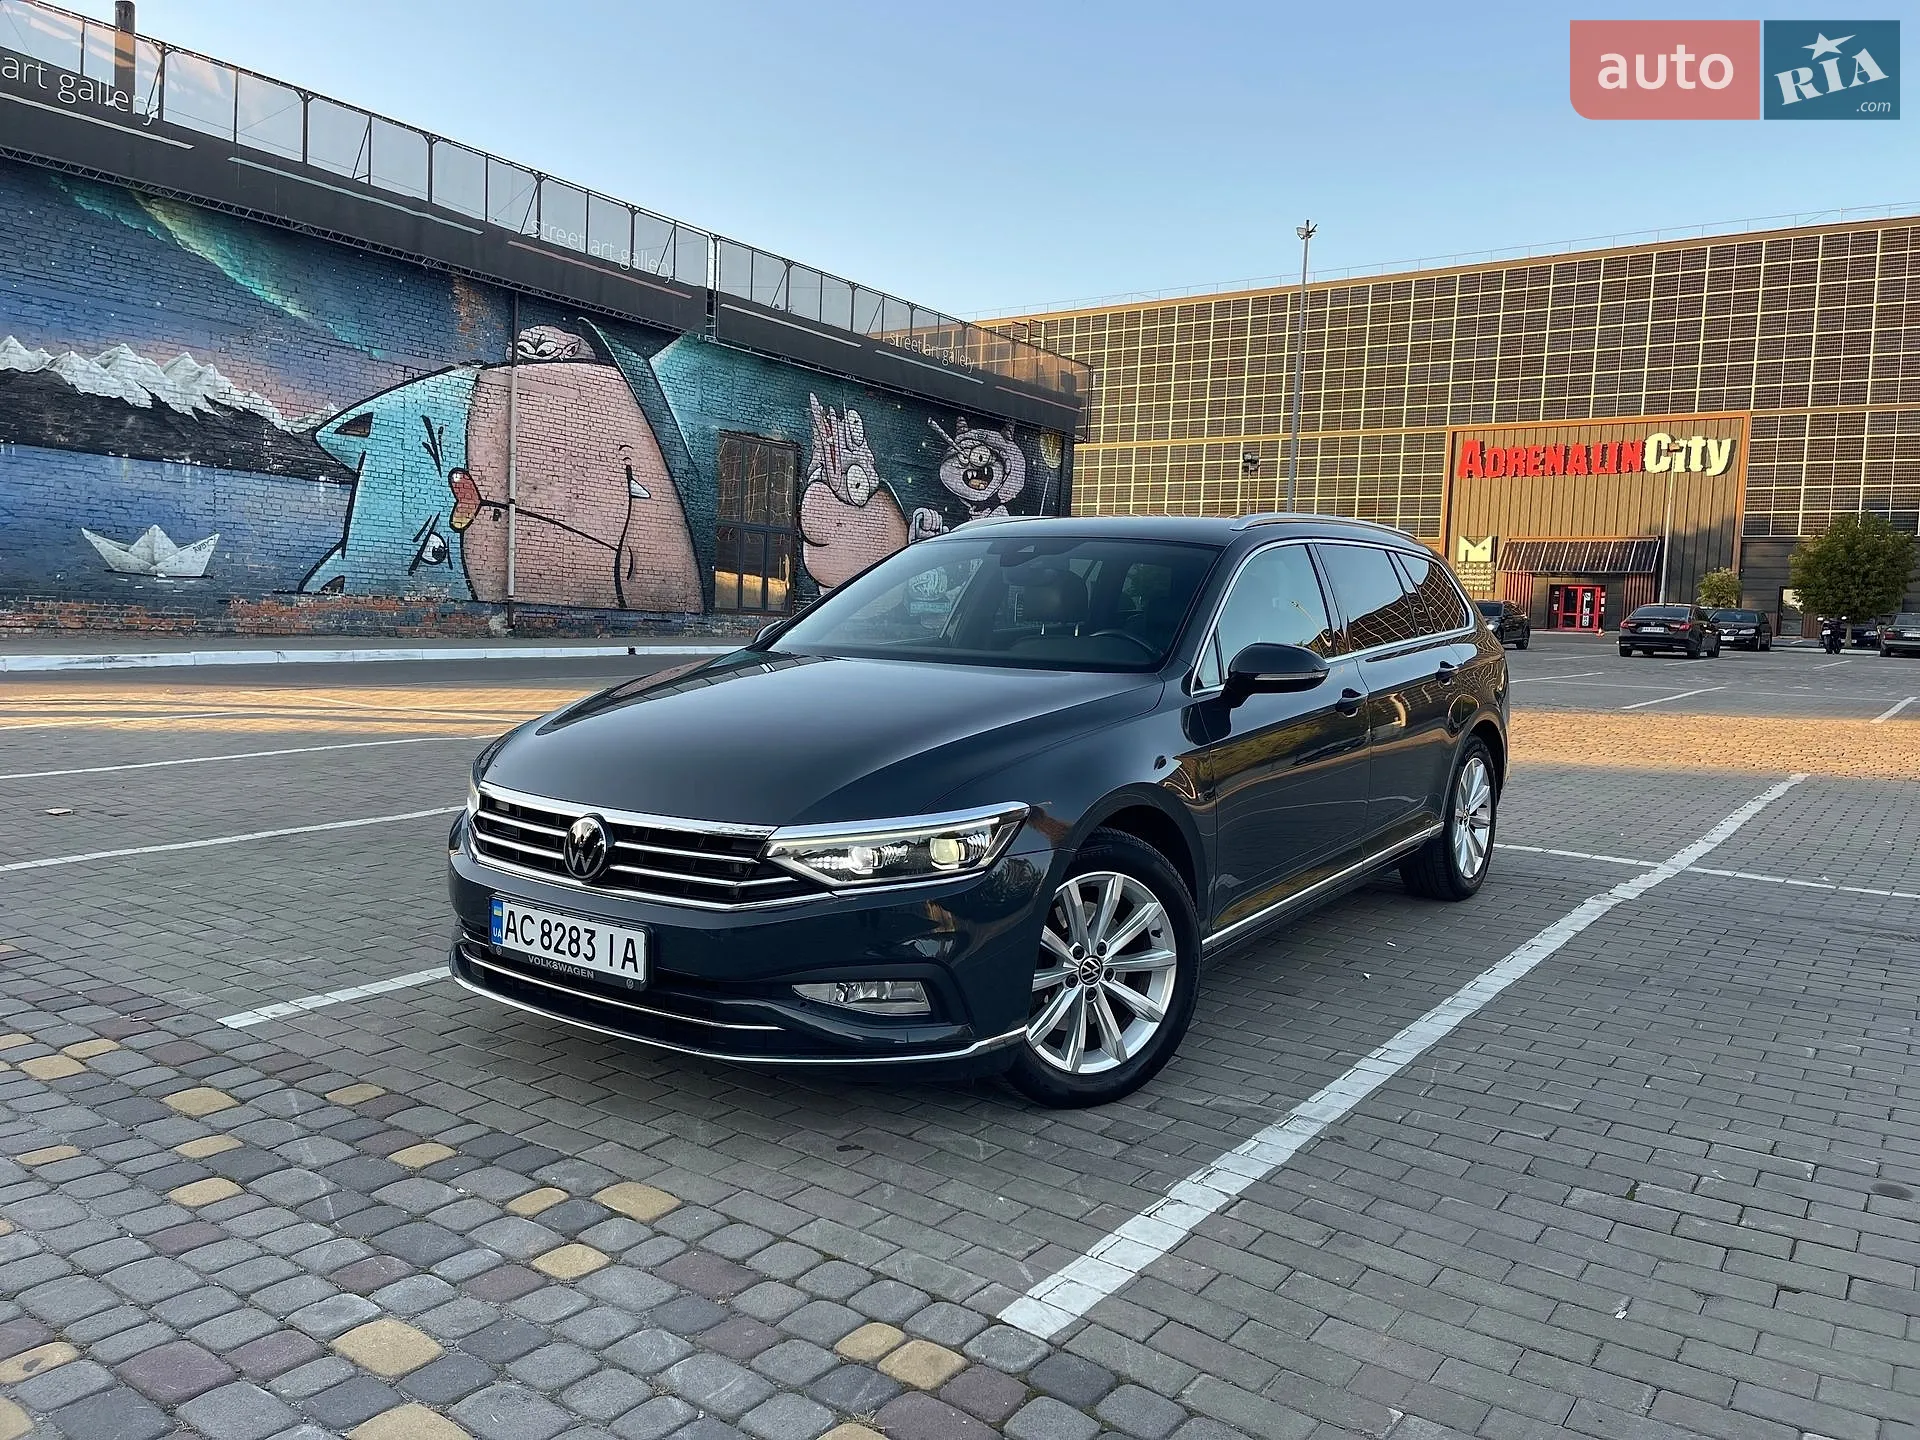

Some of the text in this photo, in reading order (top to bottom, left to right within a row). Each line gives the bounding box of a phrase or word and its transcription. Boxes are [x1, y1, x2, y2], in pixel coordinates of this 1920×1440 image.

[2, 57, 160, 126] art gallery
[531, 220, 675, 284] street art gallery
[889, 332, 922, 354] street
[941, 347, 975, 374] gallery
[492, 927, 502, 938] UA
[504, 910, 639, 973] AC 8283 IA
[527, 954, 595, 979] VOLKSWAGEN
